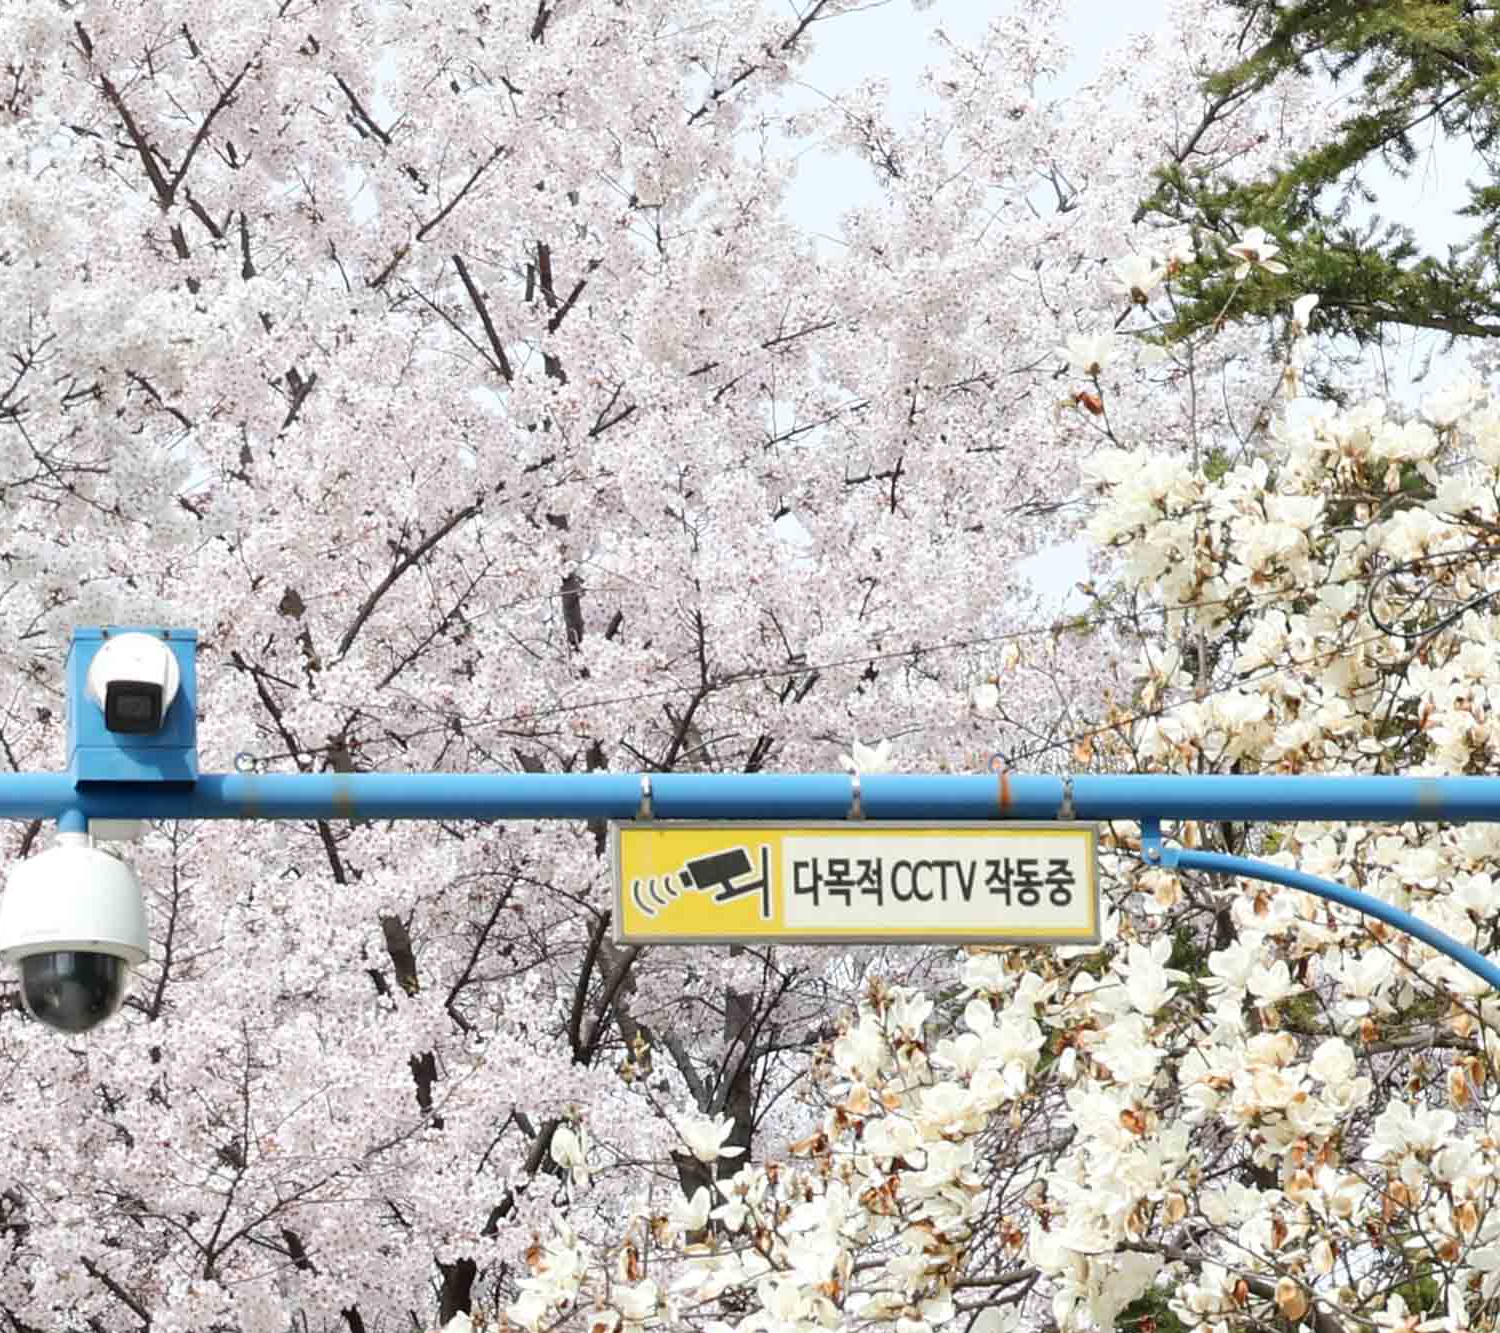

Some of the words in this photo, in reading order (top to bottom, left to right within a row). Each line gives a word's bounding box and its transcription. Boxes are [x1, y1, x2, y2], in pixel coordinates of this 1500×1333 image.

[793, 857, 884, 906] 다목적
[891, 859, 977, 902] CCTV
[985, 857, 1076, 906] 작동중
